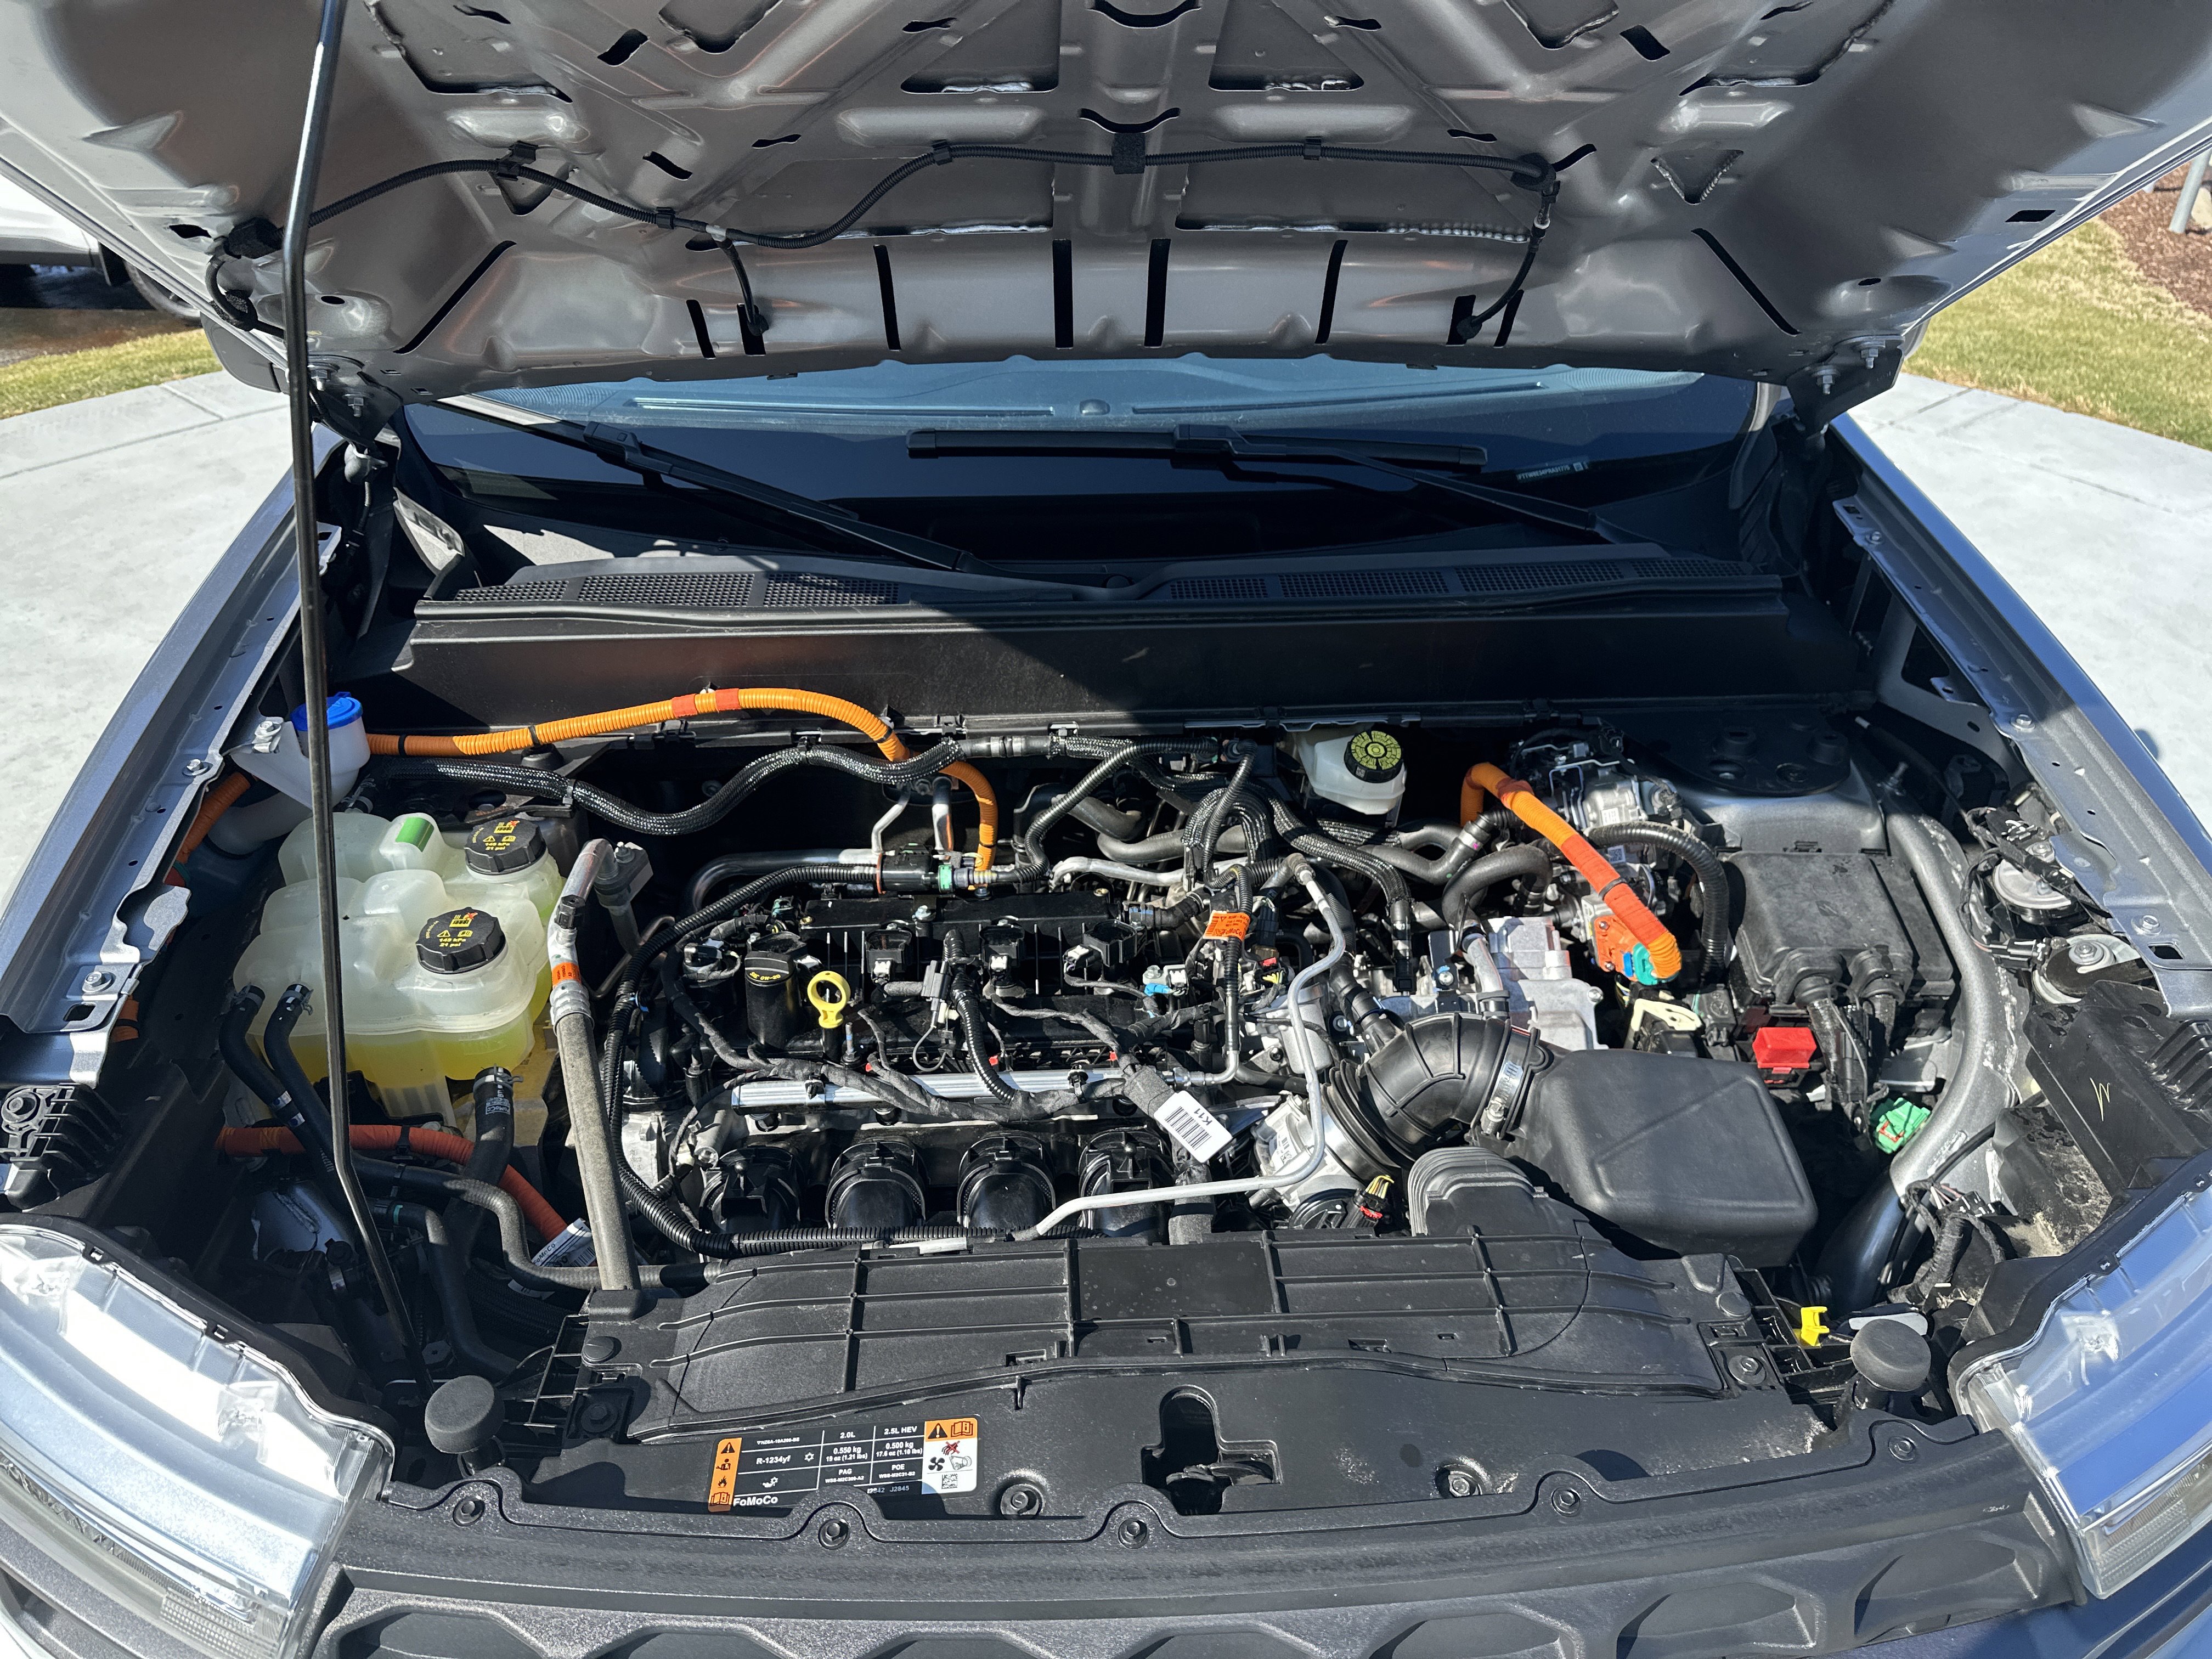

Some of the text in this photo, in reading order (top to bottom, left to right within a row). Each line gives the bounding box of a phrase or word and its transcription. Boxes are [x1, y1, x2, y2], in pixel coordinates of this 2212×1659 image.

[1194, 1108, 1212, 1126] K11
[756, 1455, 791, 1464] R-1234yf
[732, 1495, 778, 1506] FoMoCo
